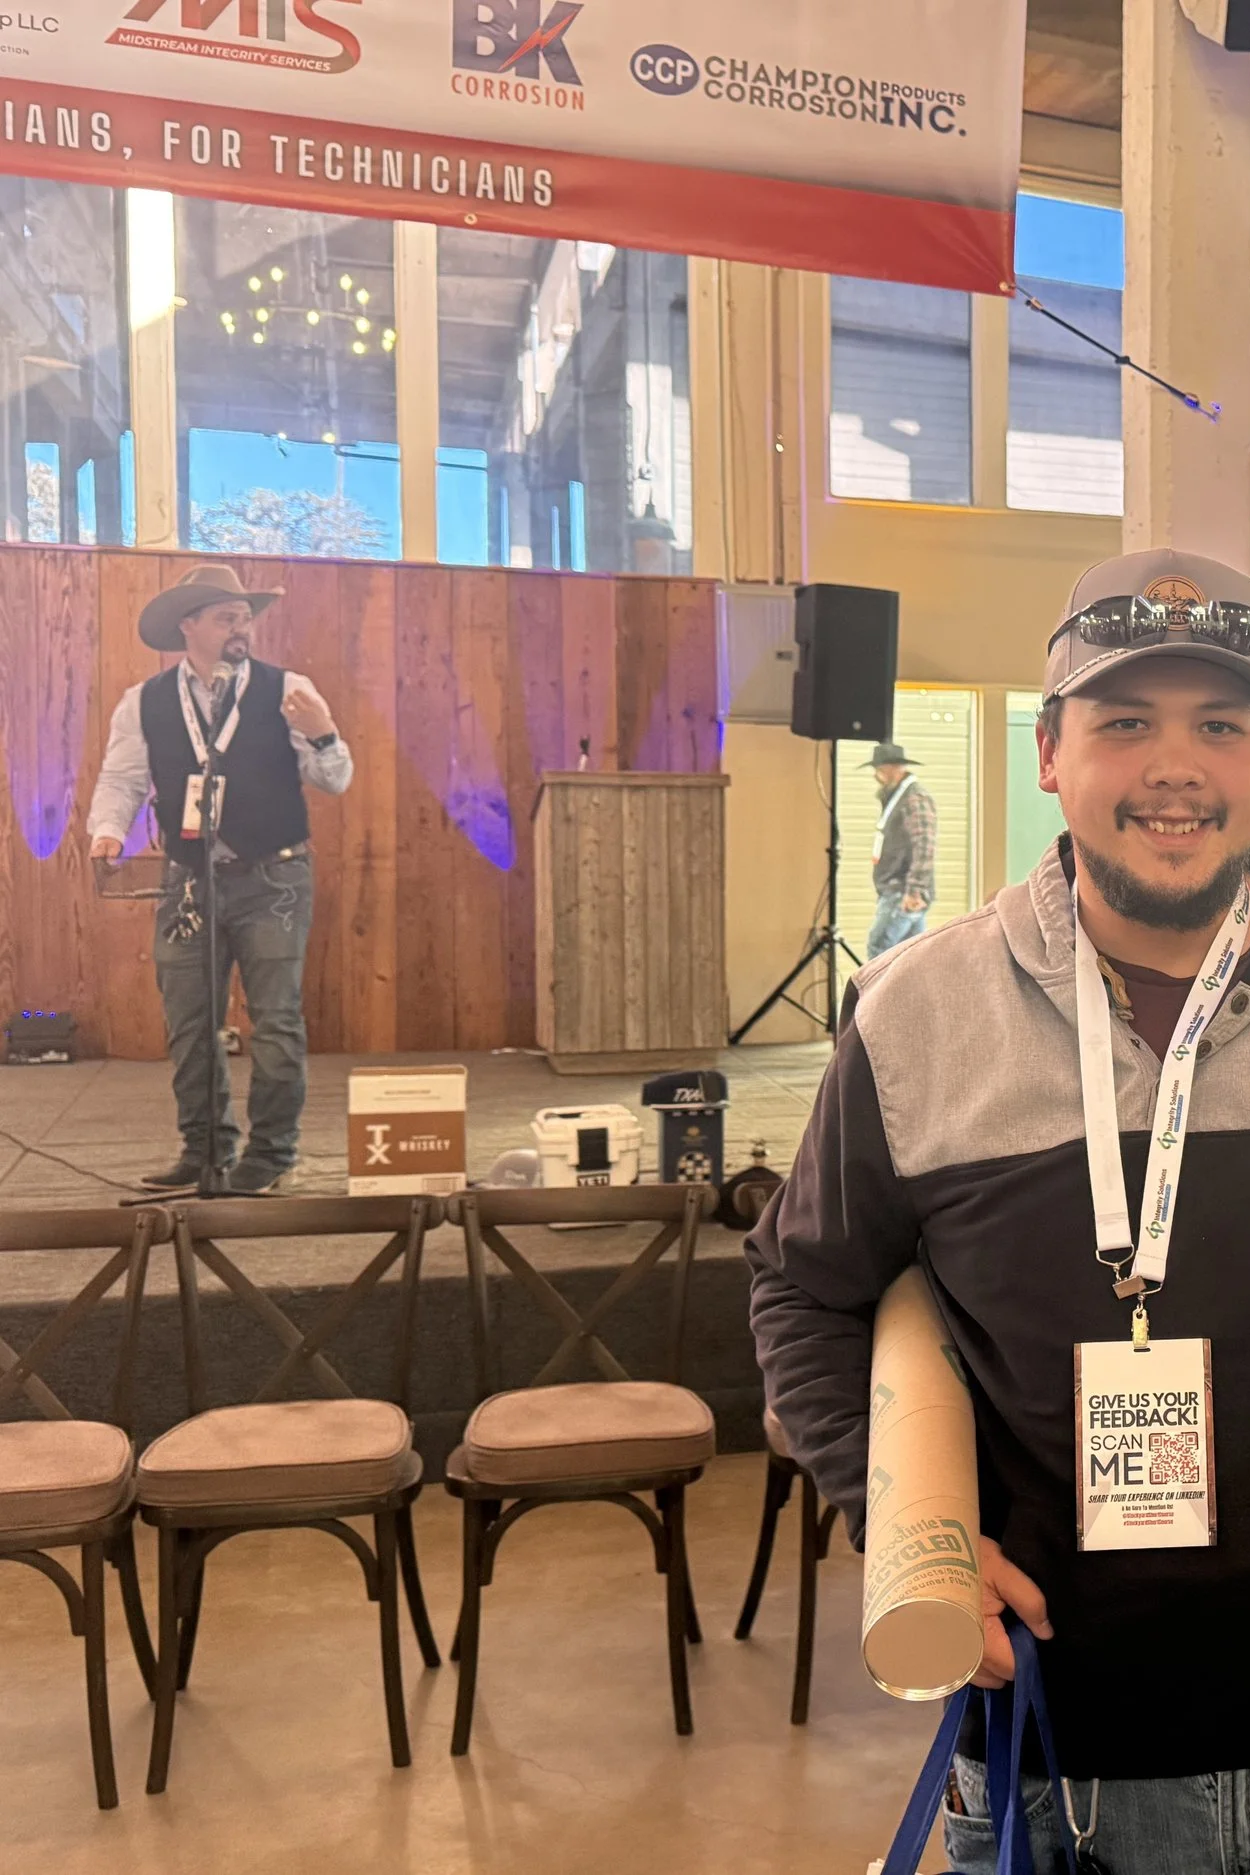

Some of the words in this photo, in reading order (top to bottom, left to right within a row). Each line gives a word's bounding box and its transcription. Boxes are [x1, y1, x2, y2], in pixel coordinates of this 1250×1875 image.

[18, 13, 60, 33] LLC
[118, 33, 200, 53] MIDSTREAM
[200, 44, 269, 63] INTEGRITY
[269, 55, 332, 72] SERVICES
[451, 74, 585, 111] CORROSION
[633, 53, 695, 86] CCP
[704, 55, 878, 101] CHAMPION
[880, 82, 966, 107] PRODUCTS
[703, 79, 879, 124] CORROSION
[879, 96, 967, 137] INC.
[163, 120, 242, 169] FOR
[269, 134, 553, 207] TECHNICIANS
[1167, 1106, 1177, 1132] Integrity
[398, 1139, 451, 1153] WHISKEY
[578, 1175, 609, 1187] YETI
[1157, 1168, 1168, 1196] Solutions
[1154, 1196, 1164, 1221] Integrity
[1089, 1394, 1125, 1409] GIVE
[1129, 1393, 1150, 1408] US
[1153, 1391, 1199, 1407] YOUR
[1089, 1406, 1199, 1429] FEEDBACK!
[1090, 1433, 1143, 1451] SCAN
[1090, 1452, 1144, 1487] ME
[1088, 1494, 1109, 1503] SHARE
[1110, 1493, 1127, 1502] YOUR
[1127, 1491, 1164, 1502] EXPERIENCE
[1165, 1491, 1175, 1501] ON
[875, 1519, 940, 1561] Doolittle
